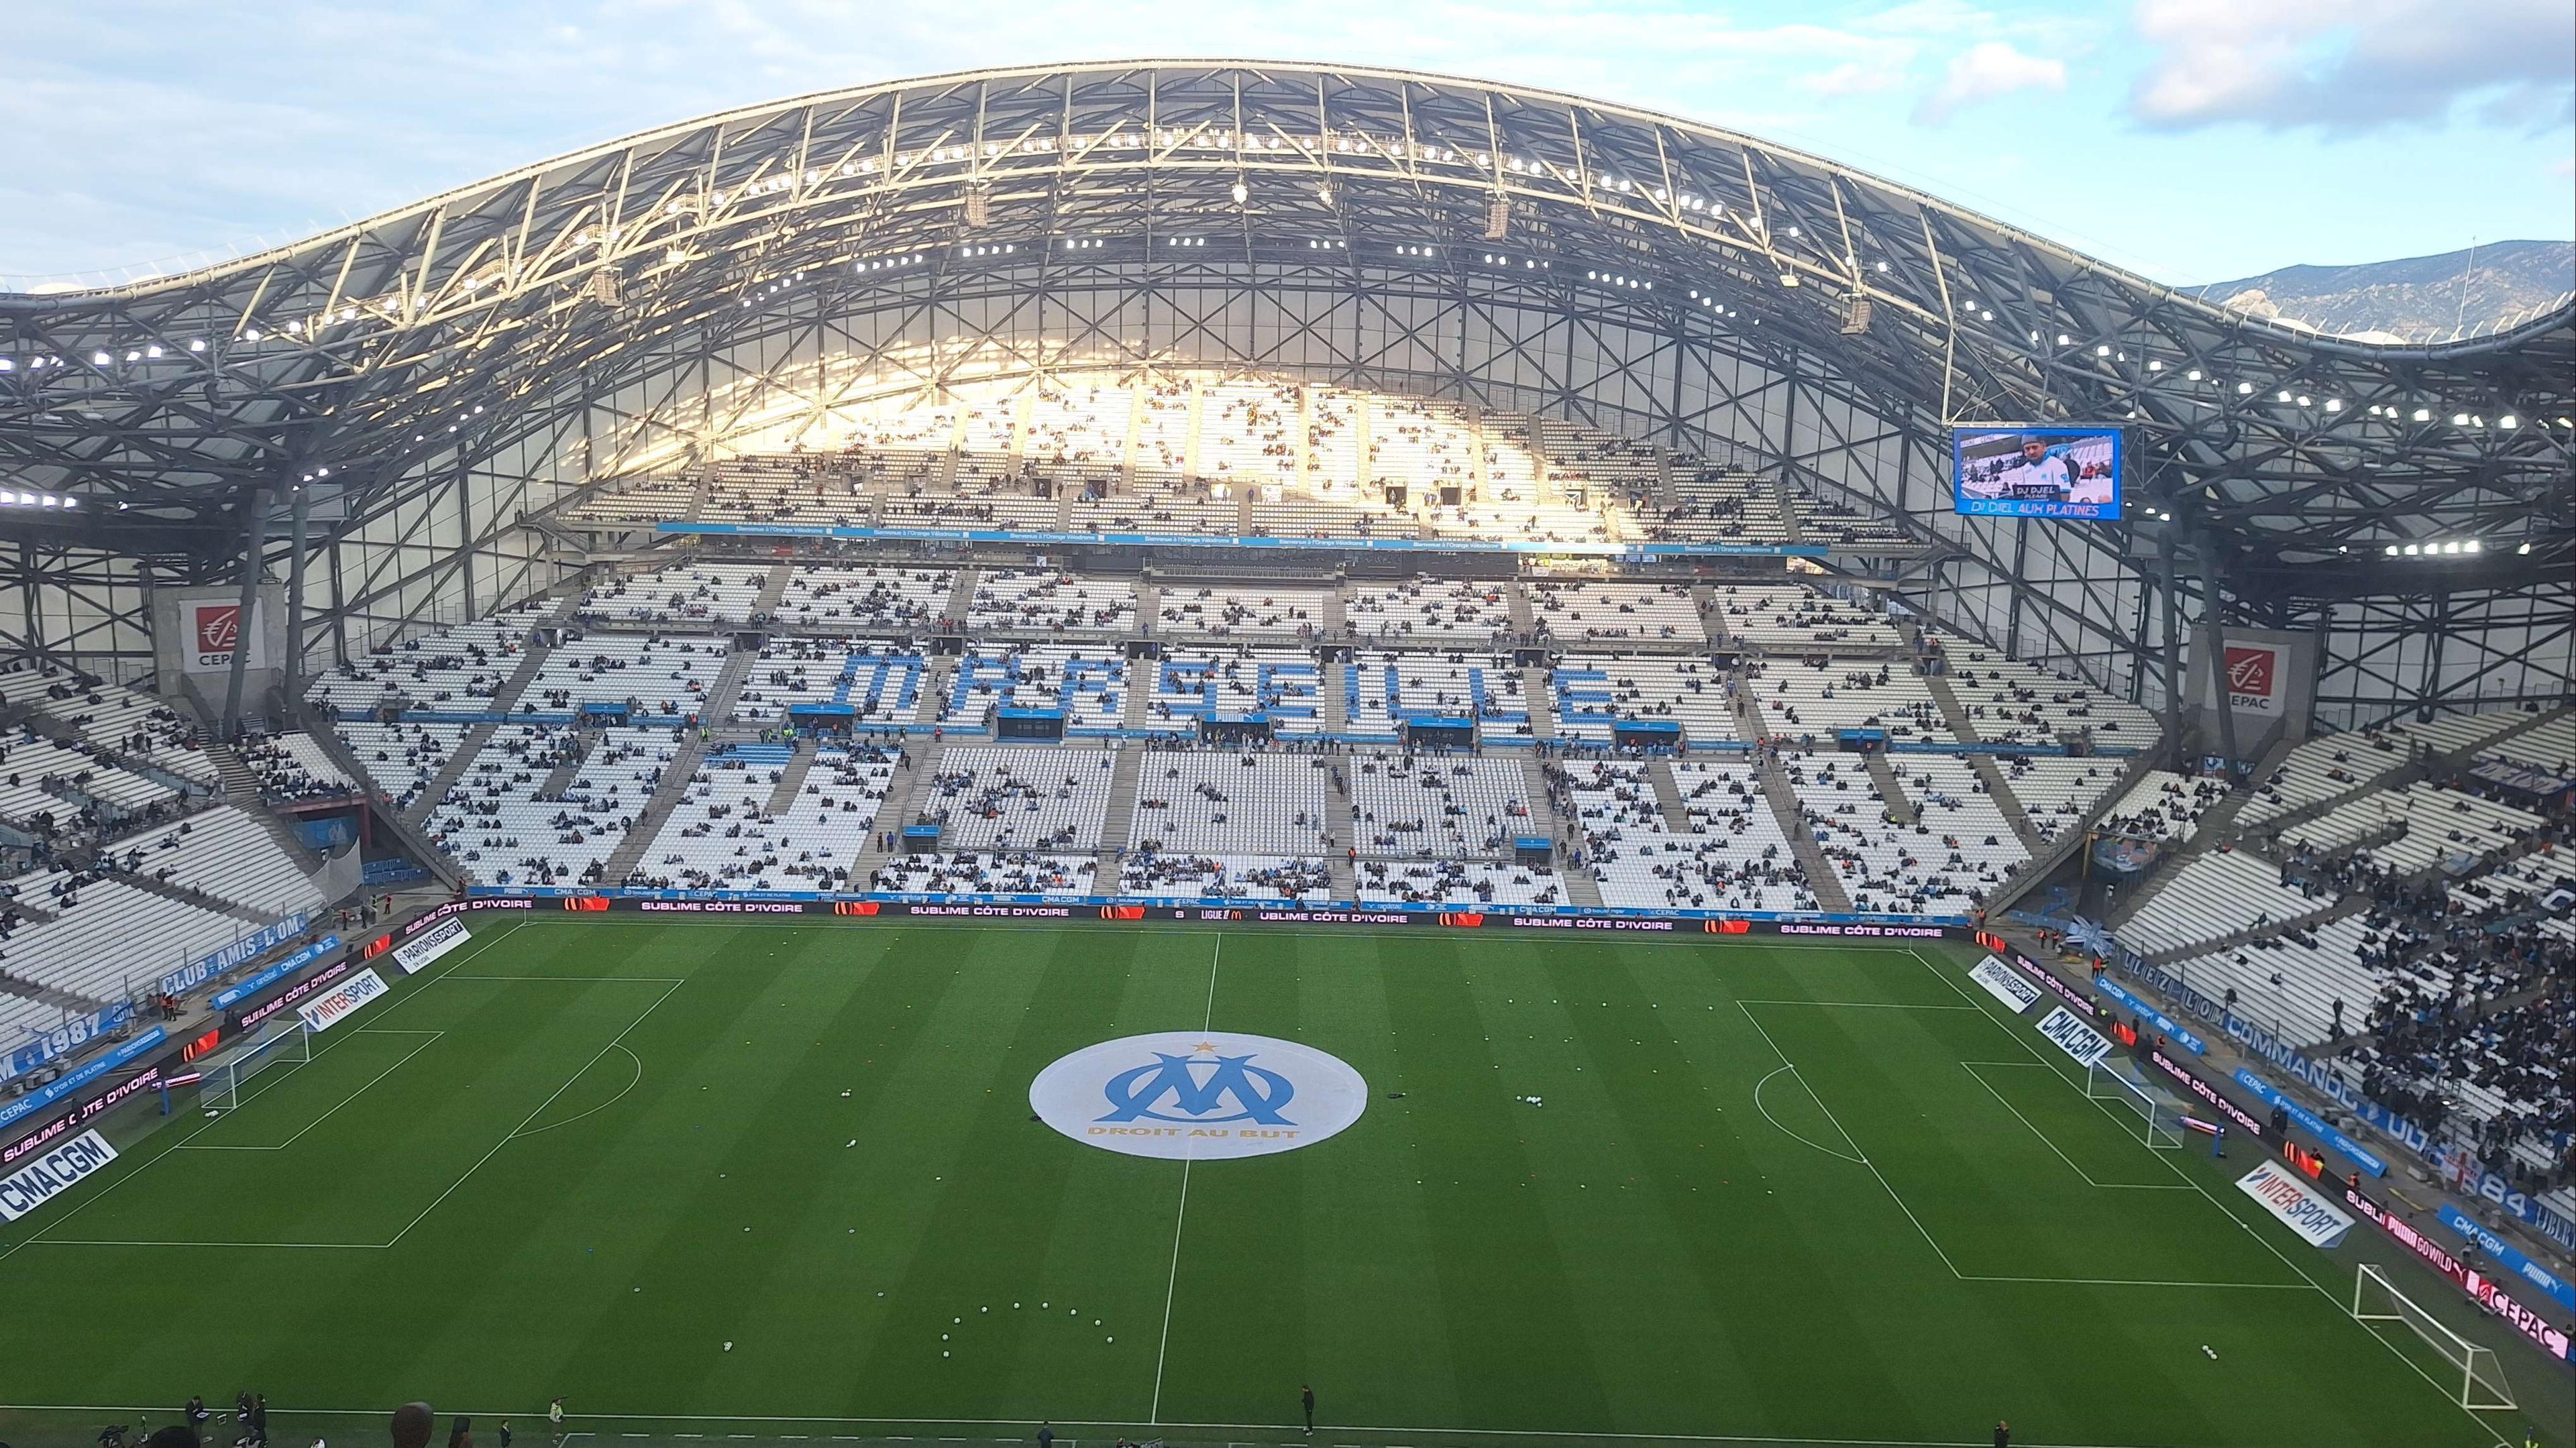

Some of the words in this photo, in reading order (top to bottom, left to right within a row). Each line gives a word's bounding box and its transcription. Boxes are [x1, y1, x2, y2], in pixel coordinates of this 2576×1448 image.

[2017, 504, 2043, 514] AUX
[2047, 504, 2099, 516] PLATINES
[833, 655, 1616, 724] MARSEILLE
[2231, 695, 2270, 709] EPAC
[405, 911, 436, 935] SUBLIME
[437, 902, 468, 917] CÔTE
[472, 900, 532, 909] D'IVOIRE
[642, 902, 701, 911] SUBLIME
[706, 901, 741, 912] CÔTE
[745, 904, 802, 913] D'IVOIRE
[911, 906, 969, 915] SUBLIME
[973, 905, 1009, 915] CÔTE
[1012, 907, 1069, 916] D'IVOIRE
[1201, 910, 1223, 920] LIGUE
[1260, 913, 1308, 922] UBLIME
[1313, 911, 1347, 922] CÔTE
[1352, 914, 1407, 923] D'IVOIRE
[1513, 917, 1572, 927] SUBLIME
[1576, 917, 1611, 928] CÔTE
[1615, 920, 1673, 930] D'IVOIRE
[1780, 924, 1840, 934] SUBLIME
[1845, 924, 1883, 936] CÔTE
[1884, 928, 1943, 937] D'IVOIRE
[162, 960, 207, 996] CLUB
[217, 936, 256, 970] AMIS
[263, 917, 299, 947] L'OM
[285, 981, 310, 1003] CÔTE
[311, 962, 347, 989] D'IVOIRE
[2018, 955, 2046, 981] SUBLIME
[2064, 989, 2094, 1017] D'IVOIRE
[41, 1011, 100, 1061] 1987
[1, 1099, 34, 1123] CEPAC
[76, 1073, 85, 1081] DE
[2152, 1051, 2191, 1086] SUBLIME
[2192, 1082, 2216, 1104] CÔTE
[2218, 1097, 2261, 1136] D'IVOIRE
[2243, 1074, 2267, 1095] CEPAC
[4, 1118, 66, 1163] SUBLIME
[68, 1099, 104, 1126] CTE
[106, 1068, 158, 1103] D'IVOIRE
[1087, 1127, 1183, 1137] DROIT
[1187, 1128, 1229, 1137] AU
[1240, 1129, 1301, 1139] BUT
[2481, 1173, 2526, 1218] 84
[2492, 1290, 2559, 1349] CEPAC
